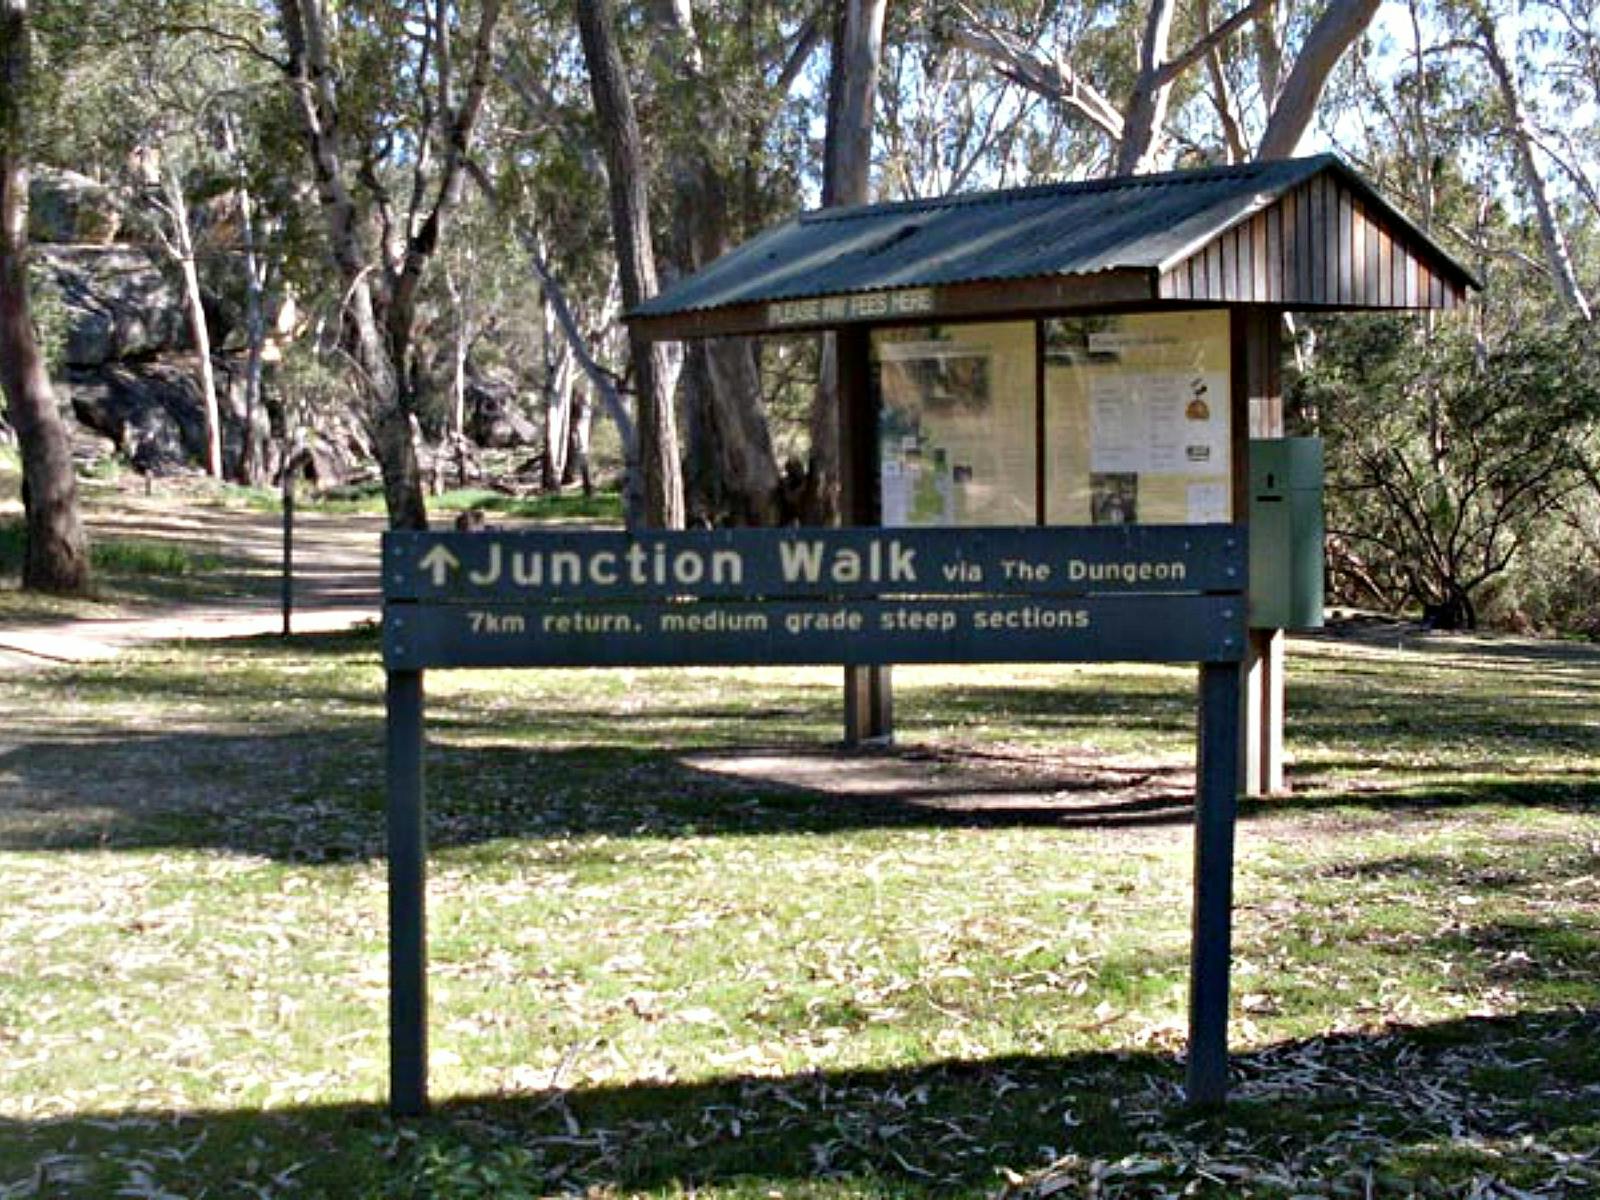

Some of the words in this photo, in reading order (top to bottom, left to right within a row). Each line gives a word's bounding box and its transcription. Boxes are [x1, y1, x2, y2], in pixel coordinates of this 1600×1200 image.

[469, 542, 743, 586] Junction
[779, 540, 917, 583] Walk
[942, 561, 982, 582] via
[1001, 560, 1050, 581] The
[1068, 559, 1187, 583] Dungeon
[467, 611, 525, 632] 7km
[660, 610, 768, 631] medium
[785, 609, 862, 635] grade
[880, 608, 956, 631] steep
[973, 607, 1090, 628] sections
